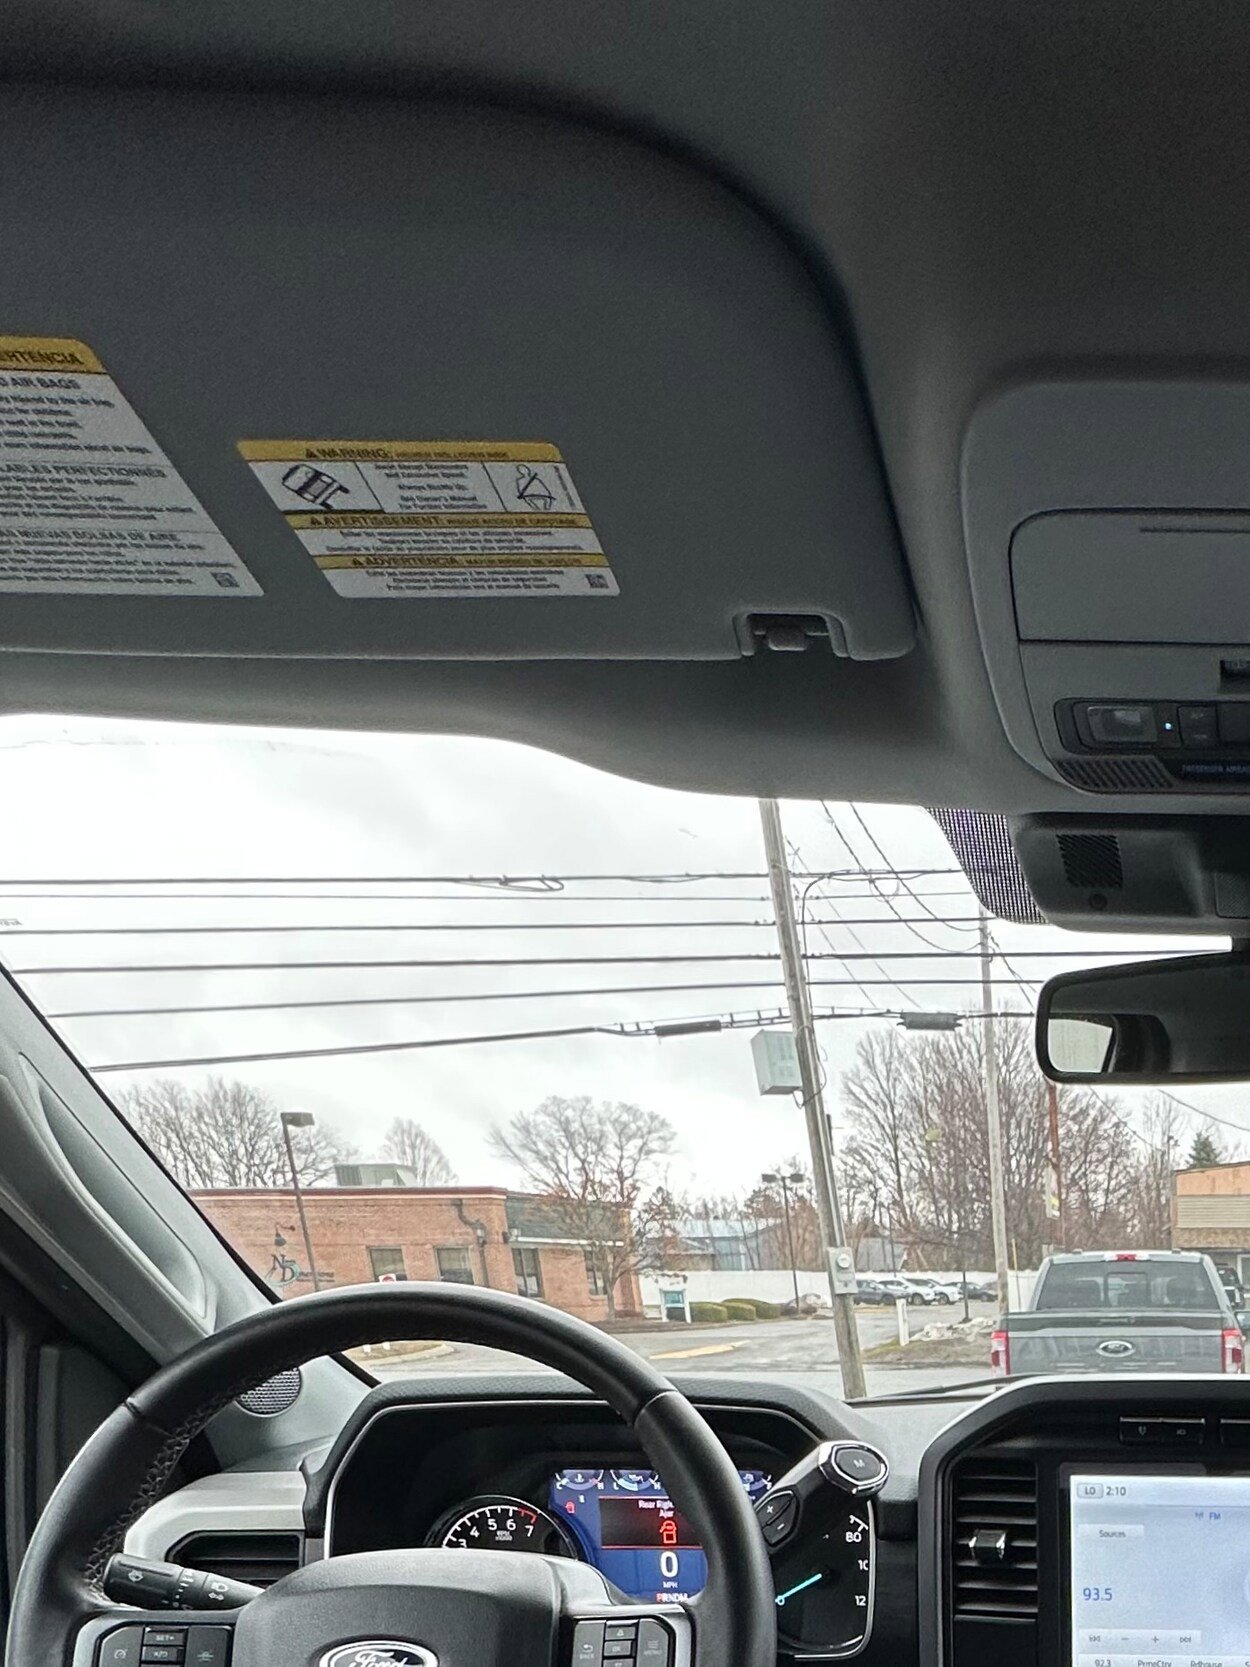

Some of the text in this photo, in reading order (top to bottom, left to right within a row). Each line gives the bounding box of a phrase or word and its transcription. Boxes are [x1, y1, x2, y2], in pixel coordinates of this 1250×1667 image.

[1106, 1486, 1126, 1496] 2:10
[638, 1500, 656, 1509] Rear
[1209, 1512, 1221, 1520] FM
[488, 1518, 498, 1531] 5
[506, 1518, 517, 1531] 6
[470, 1525, 480, 1538] 4
[524, 1524, 534, 1538] 7
[845, 1531, 862, 1542] 80
[1099, 1530, 1126, 1538] Sources
[660, 1550, 679, 1578] 0
[1082, 1587, 1113, 1601] 93.5
[1095, 1660, 1111, 1667] 92.3
